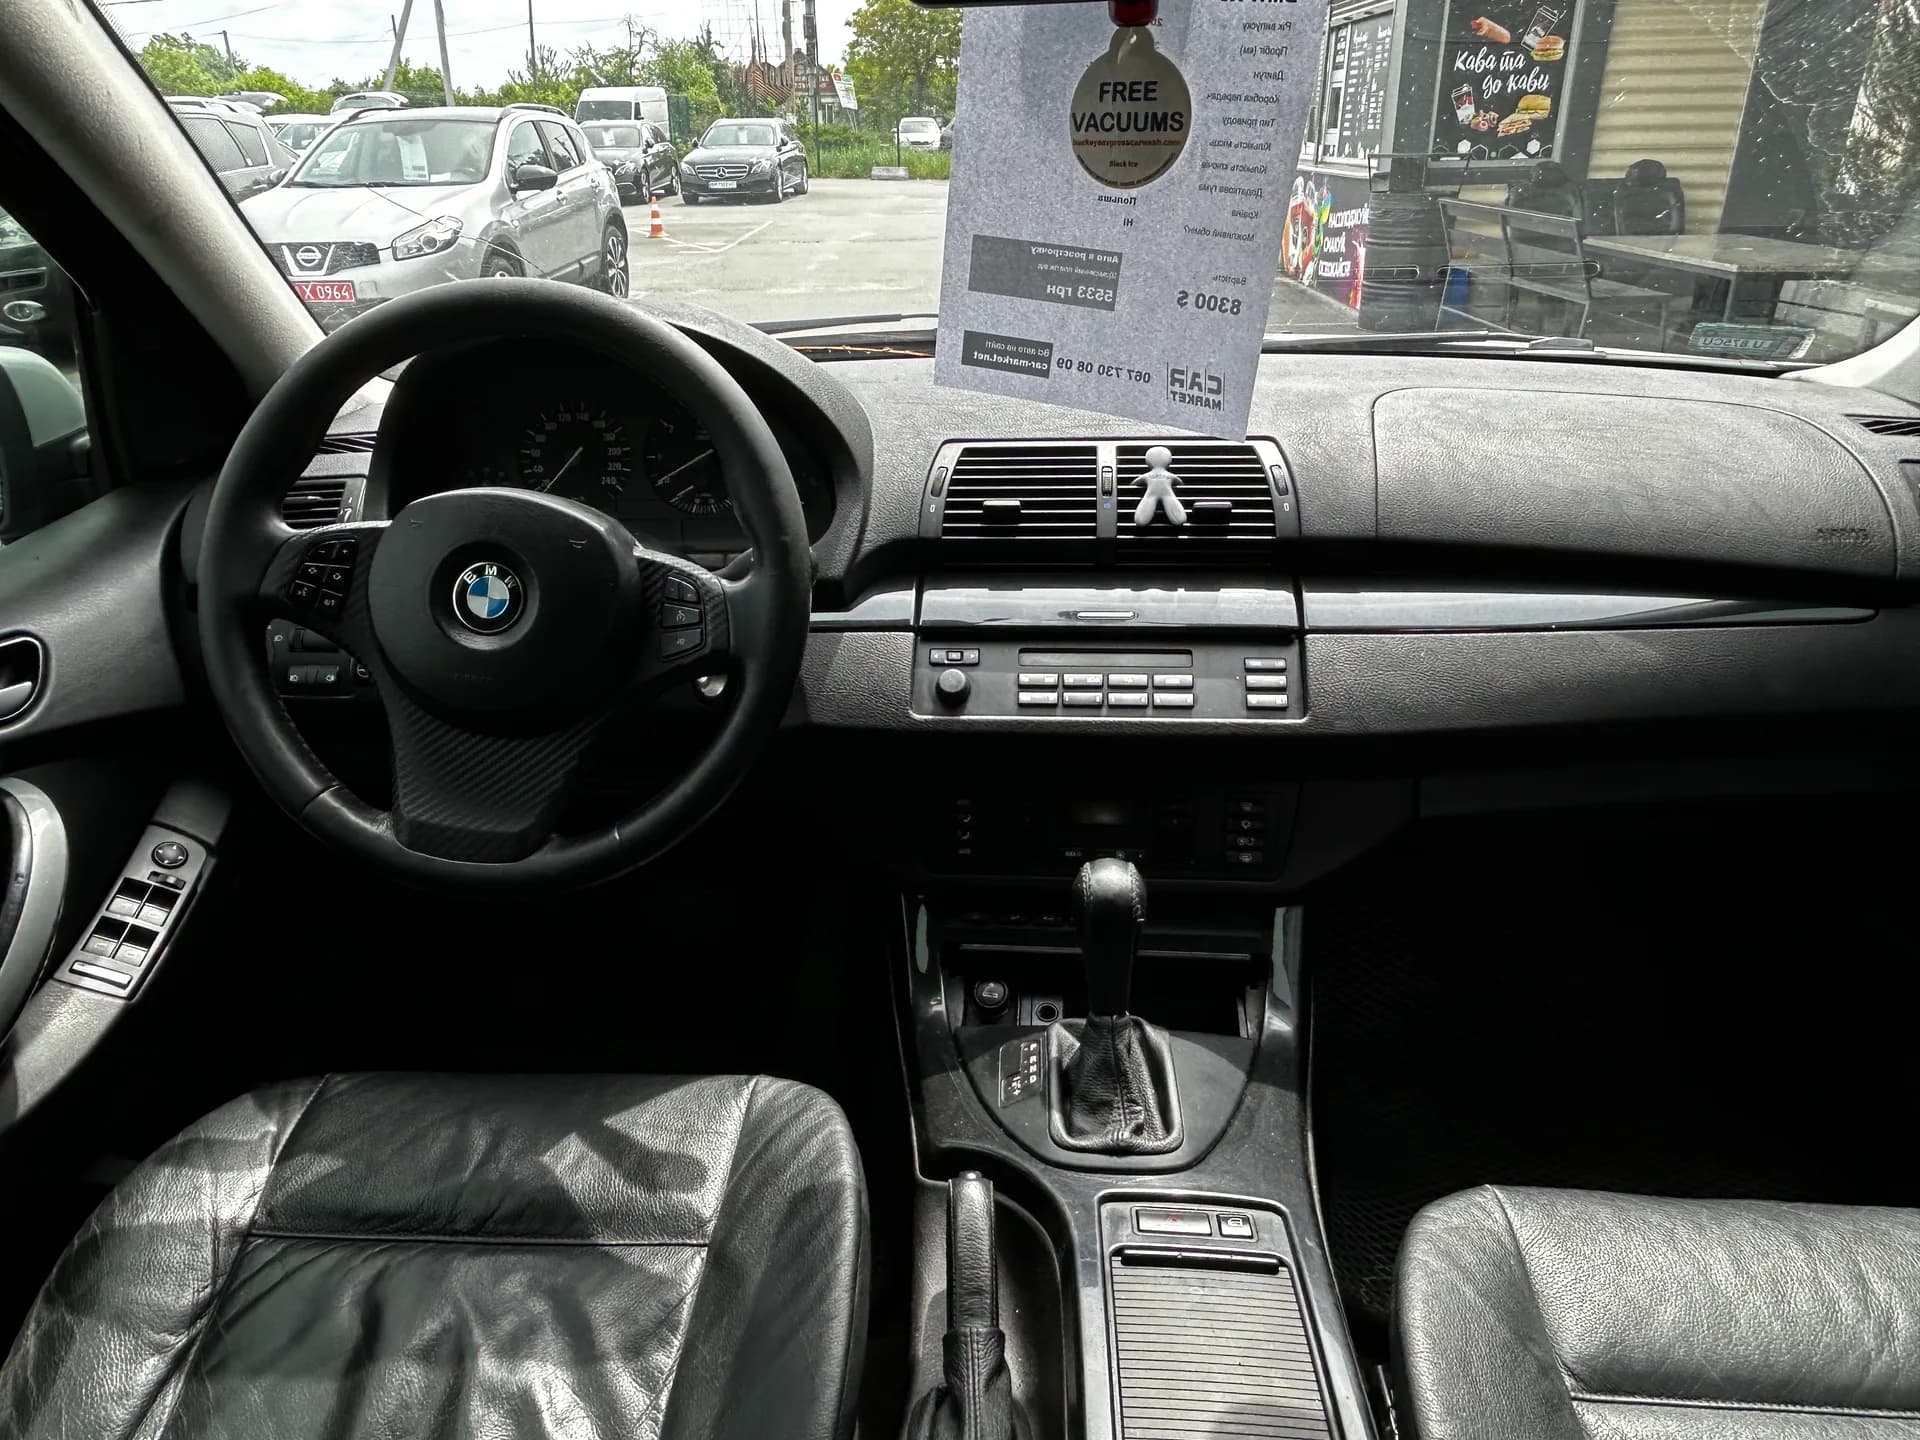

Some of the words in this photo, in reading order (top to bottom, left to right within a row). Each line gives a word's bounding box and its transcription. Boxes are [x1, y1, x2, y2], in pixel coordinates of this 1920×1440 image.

[1454, 46, 1498, 73] Кава
[1099, 80, 1158, 102] FREE
[1482, 74, 1502, 99] до
[1506, 66, 1550, 93] кави
[1072, 112, 1184, 132] VACUUMS
[316, 285, 349, 300] 0964
[463, 564, 518, 589] BMW
